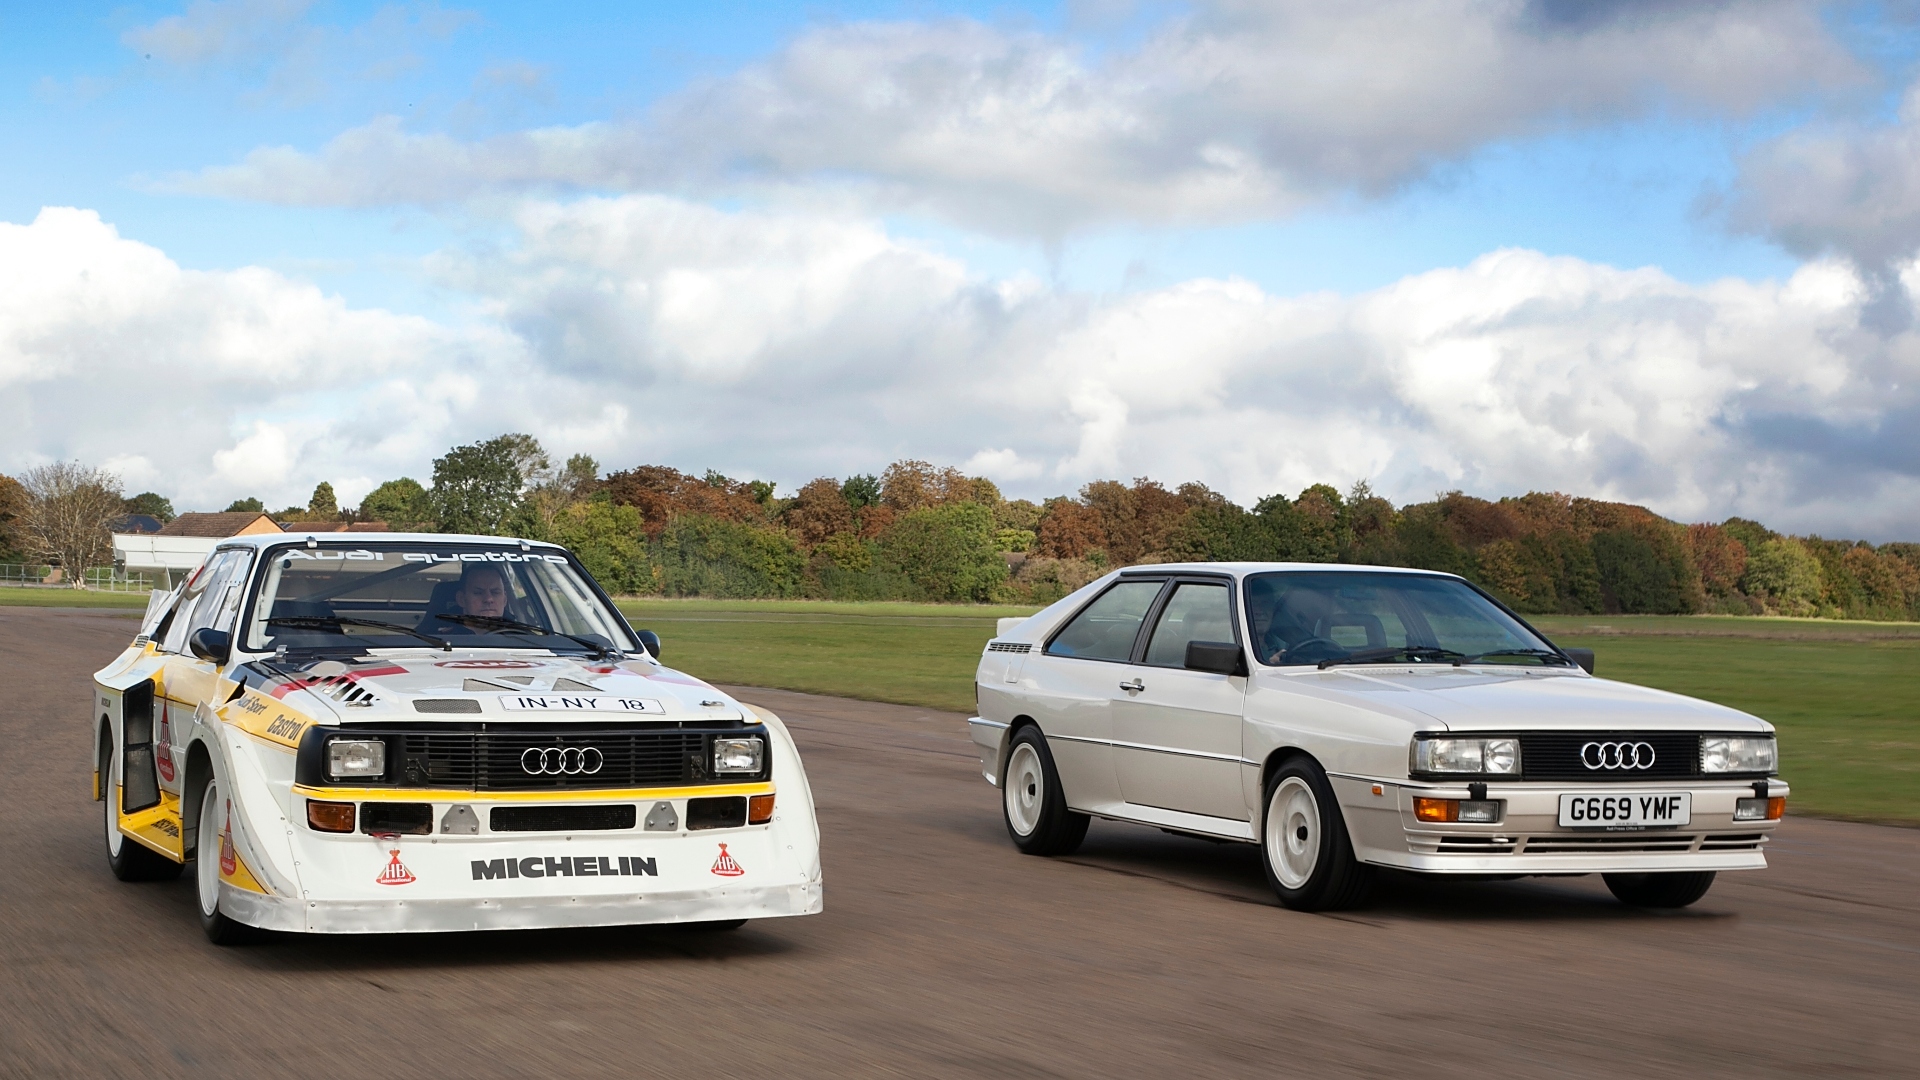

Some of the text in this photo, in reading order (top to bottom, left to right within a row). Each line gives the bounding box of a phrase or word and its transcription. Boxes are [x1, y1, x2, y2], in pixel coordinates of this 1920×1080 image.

[276, 549, 569, 564] Audi quattro
[234, 693, 269, 716] Audi Sport
[517, 697, 645, 710] IN-NY 18
[267, 714, 307, 741] Castrol
[1571, 796, 1682, 821] G669 YMF
[385, 863, 406, 879] HB
[470, 856, 659, 881] MICHELIN
[717, 856, 736, 870] HB
